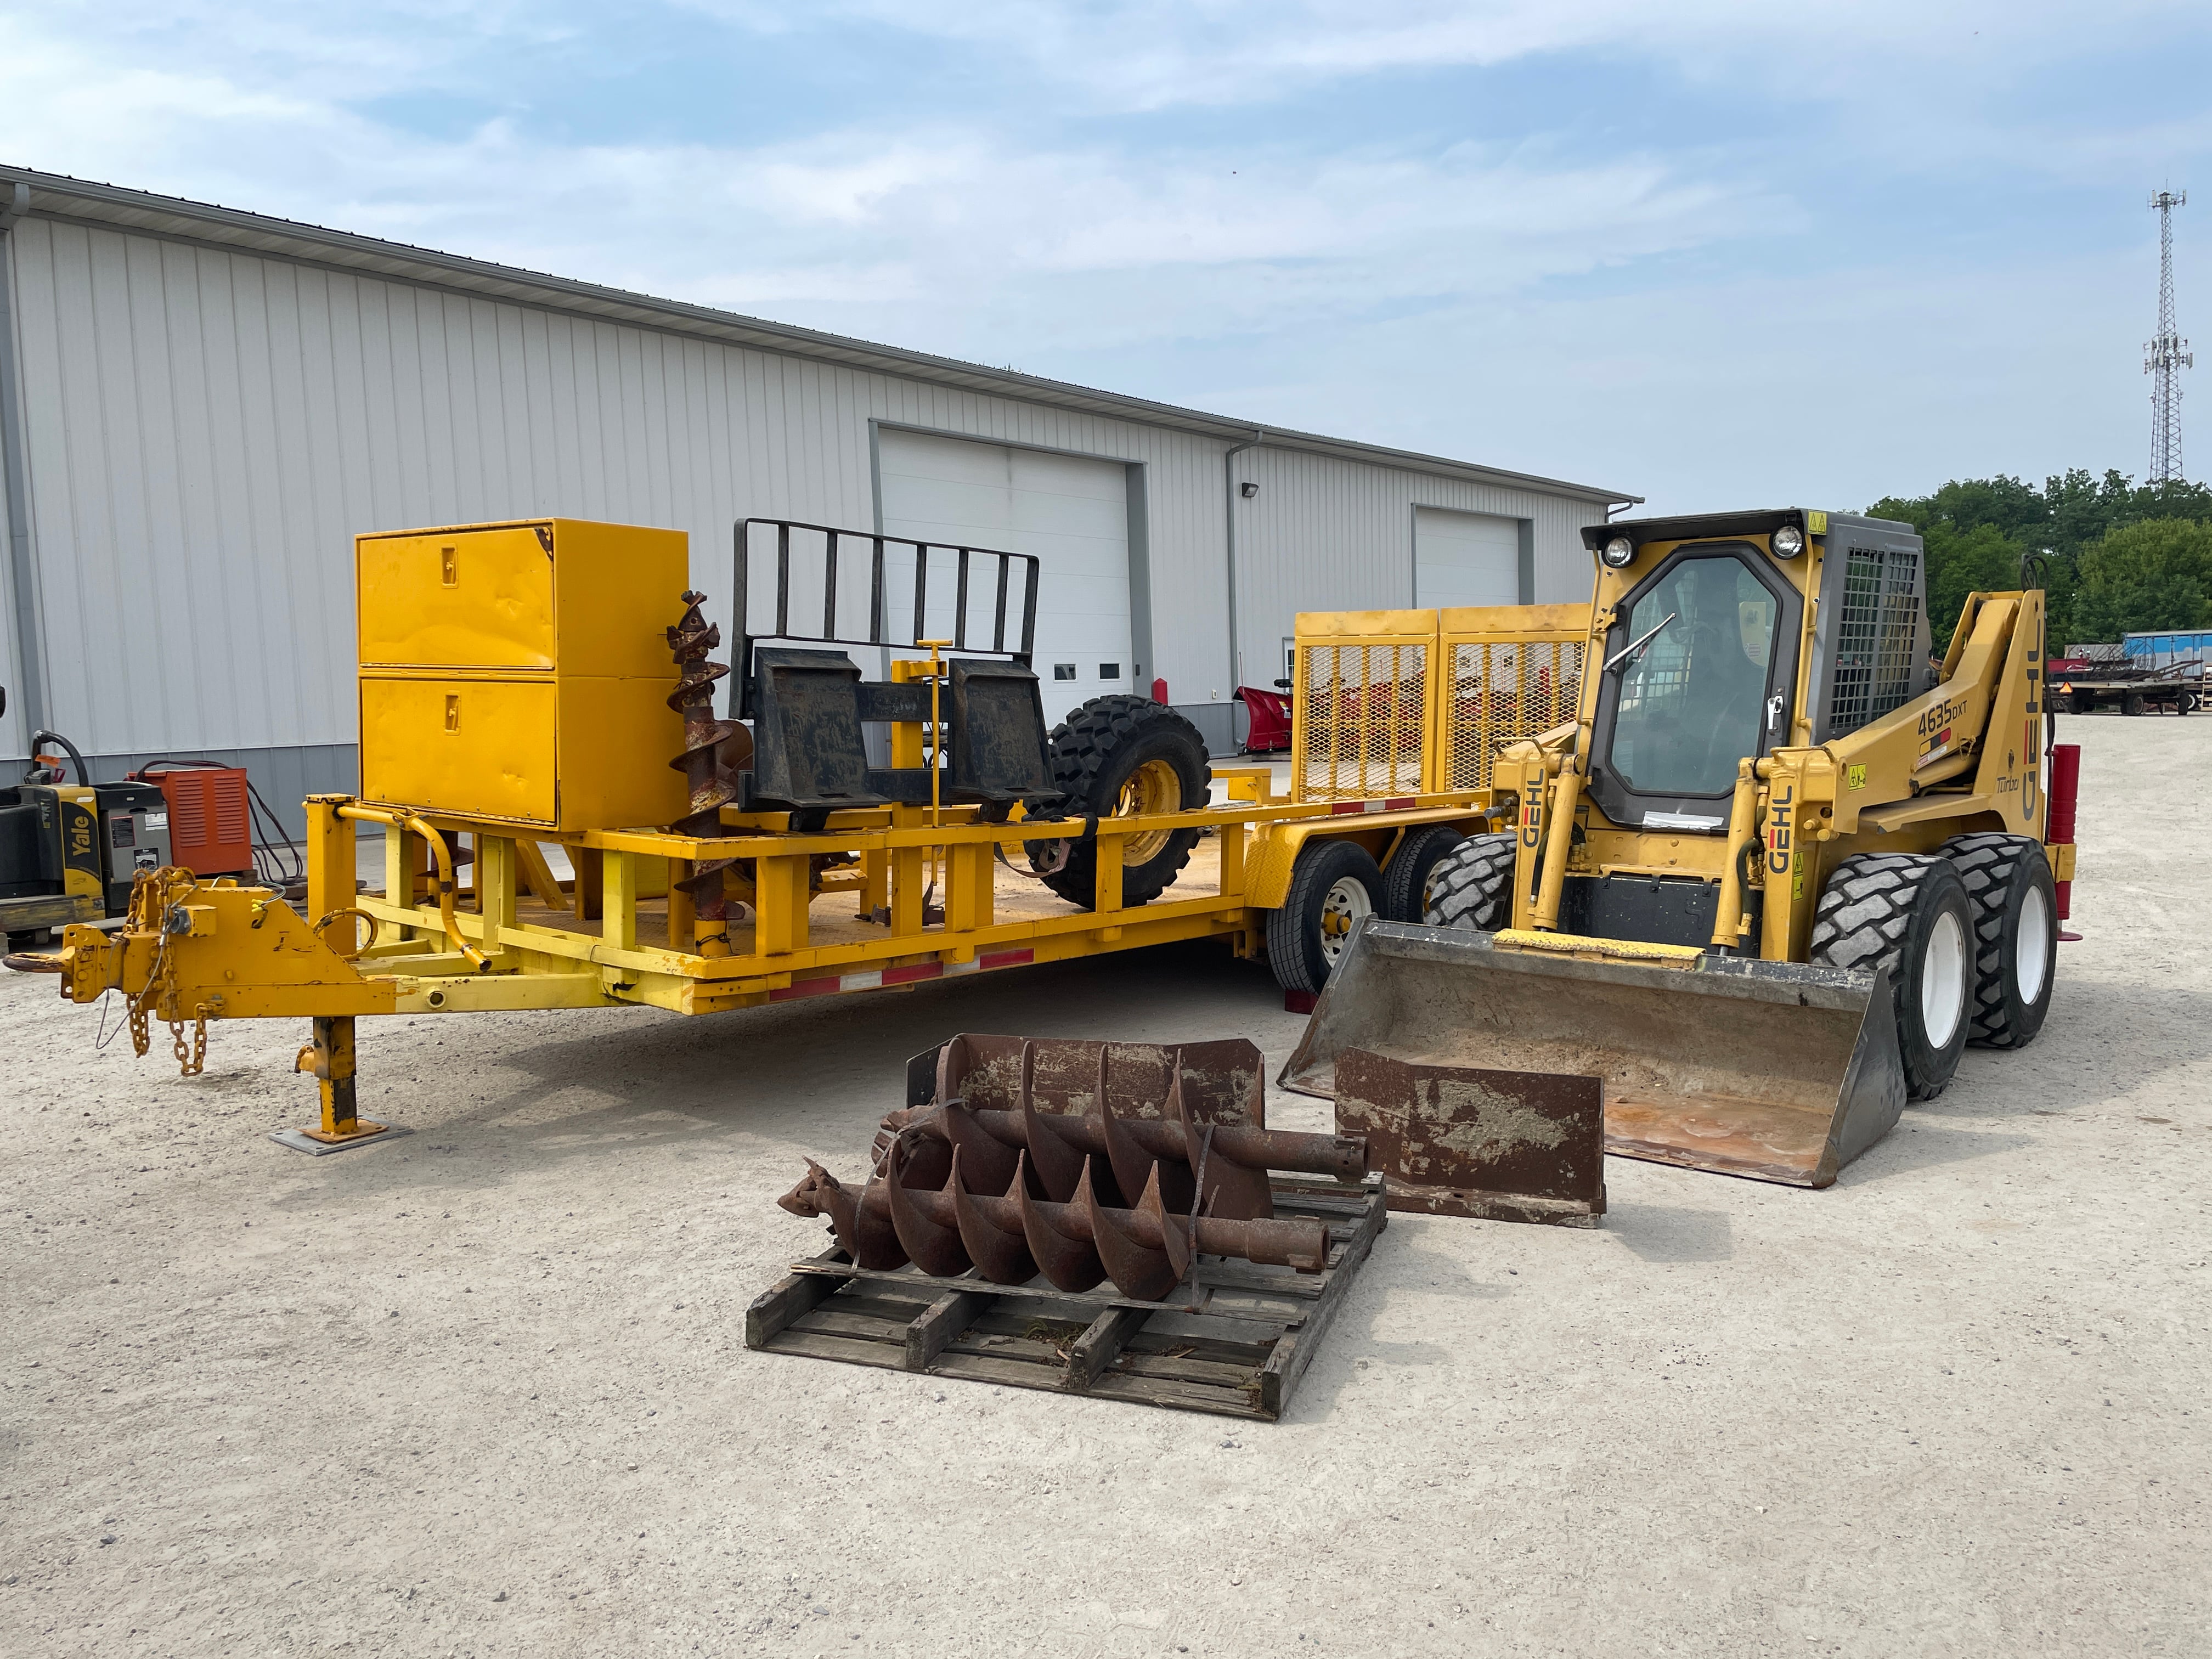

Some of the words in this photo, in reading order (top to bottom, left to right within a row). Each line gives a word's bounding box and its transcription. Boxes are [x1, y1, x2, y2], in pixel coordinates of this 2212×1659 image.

[2023, 618, 2041, 821] GEHL
[1523, 769, 1544, 848] GEHL
[1997, 775, 2019, 794] Turbo
[71, 816, 91, 856] Yale
[1769, 785, 1792, 874] GEHL
